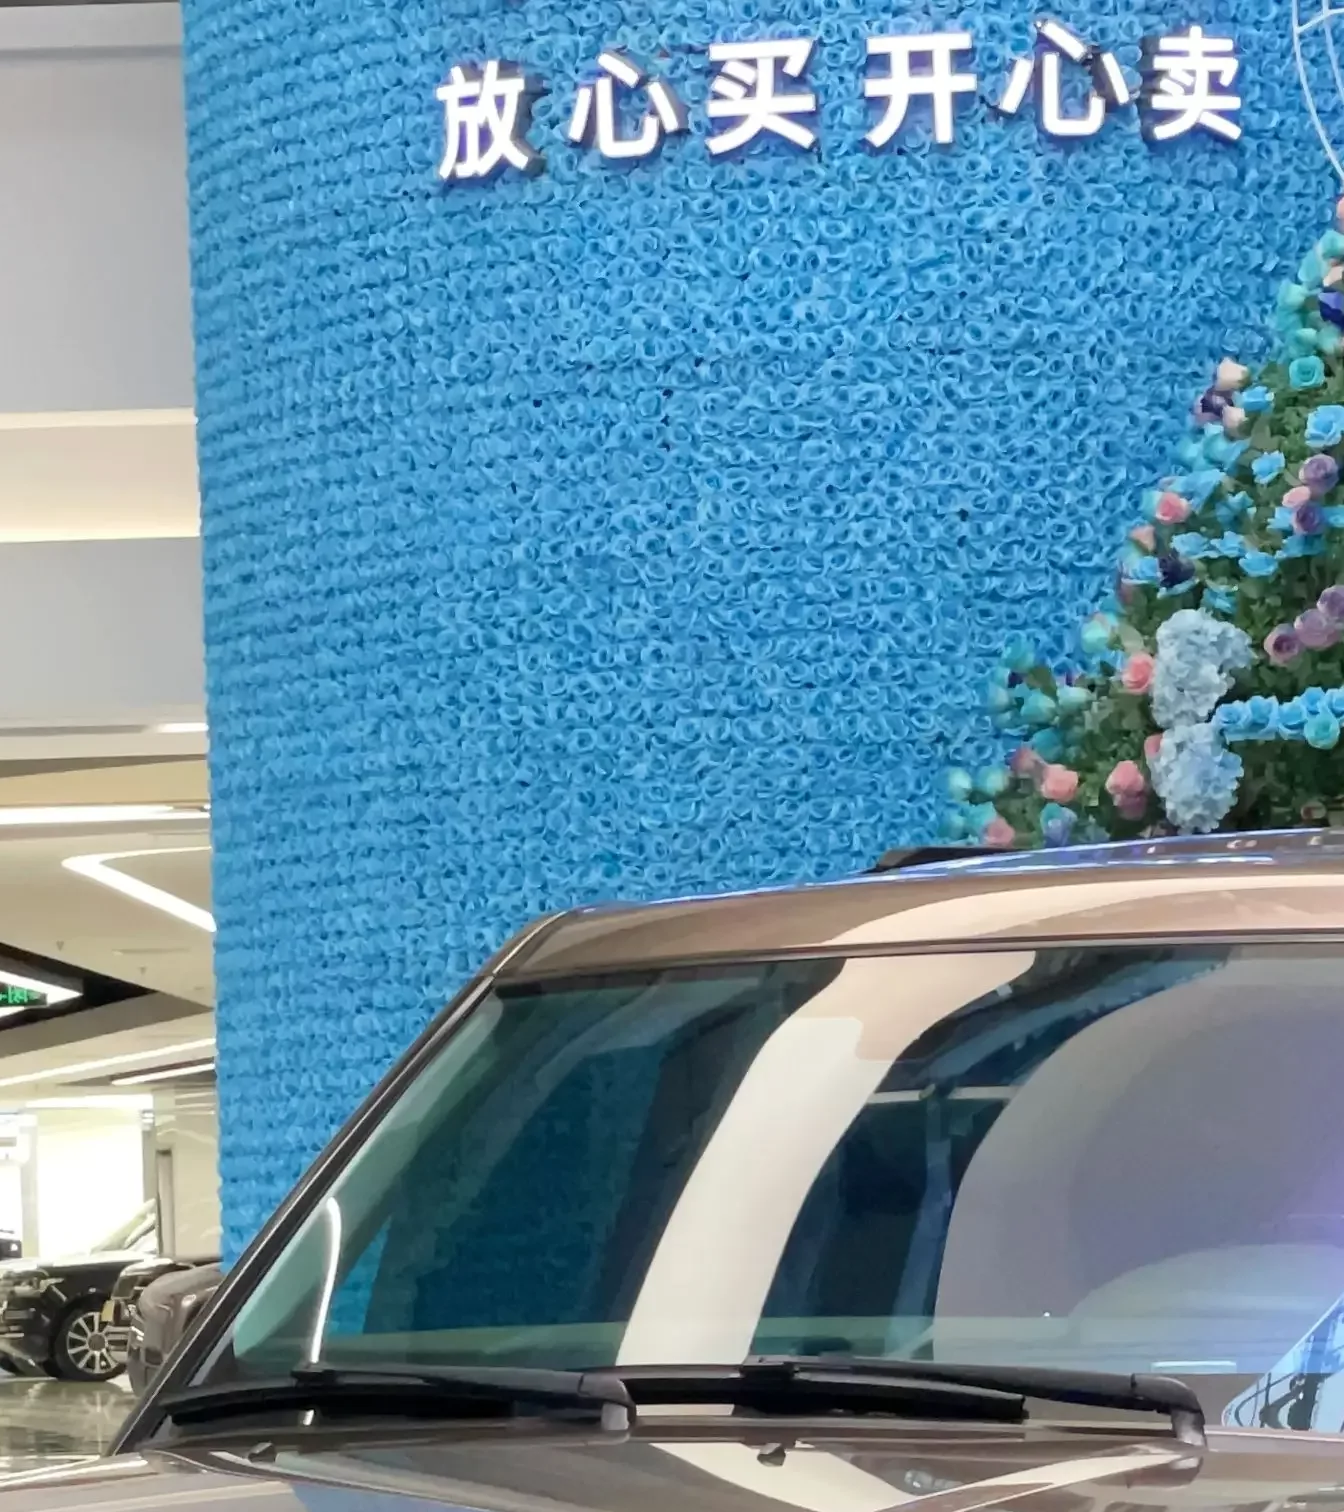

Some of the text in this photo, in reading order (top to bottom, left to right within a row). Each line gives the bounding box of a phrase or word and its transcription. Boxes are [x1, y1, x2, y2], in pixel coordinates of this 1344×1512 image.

[436, 19, 1243, 180] 放心买开心卖
